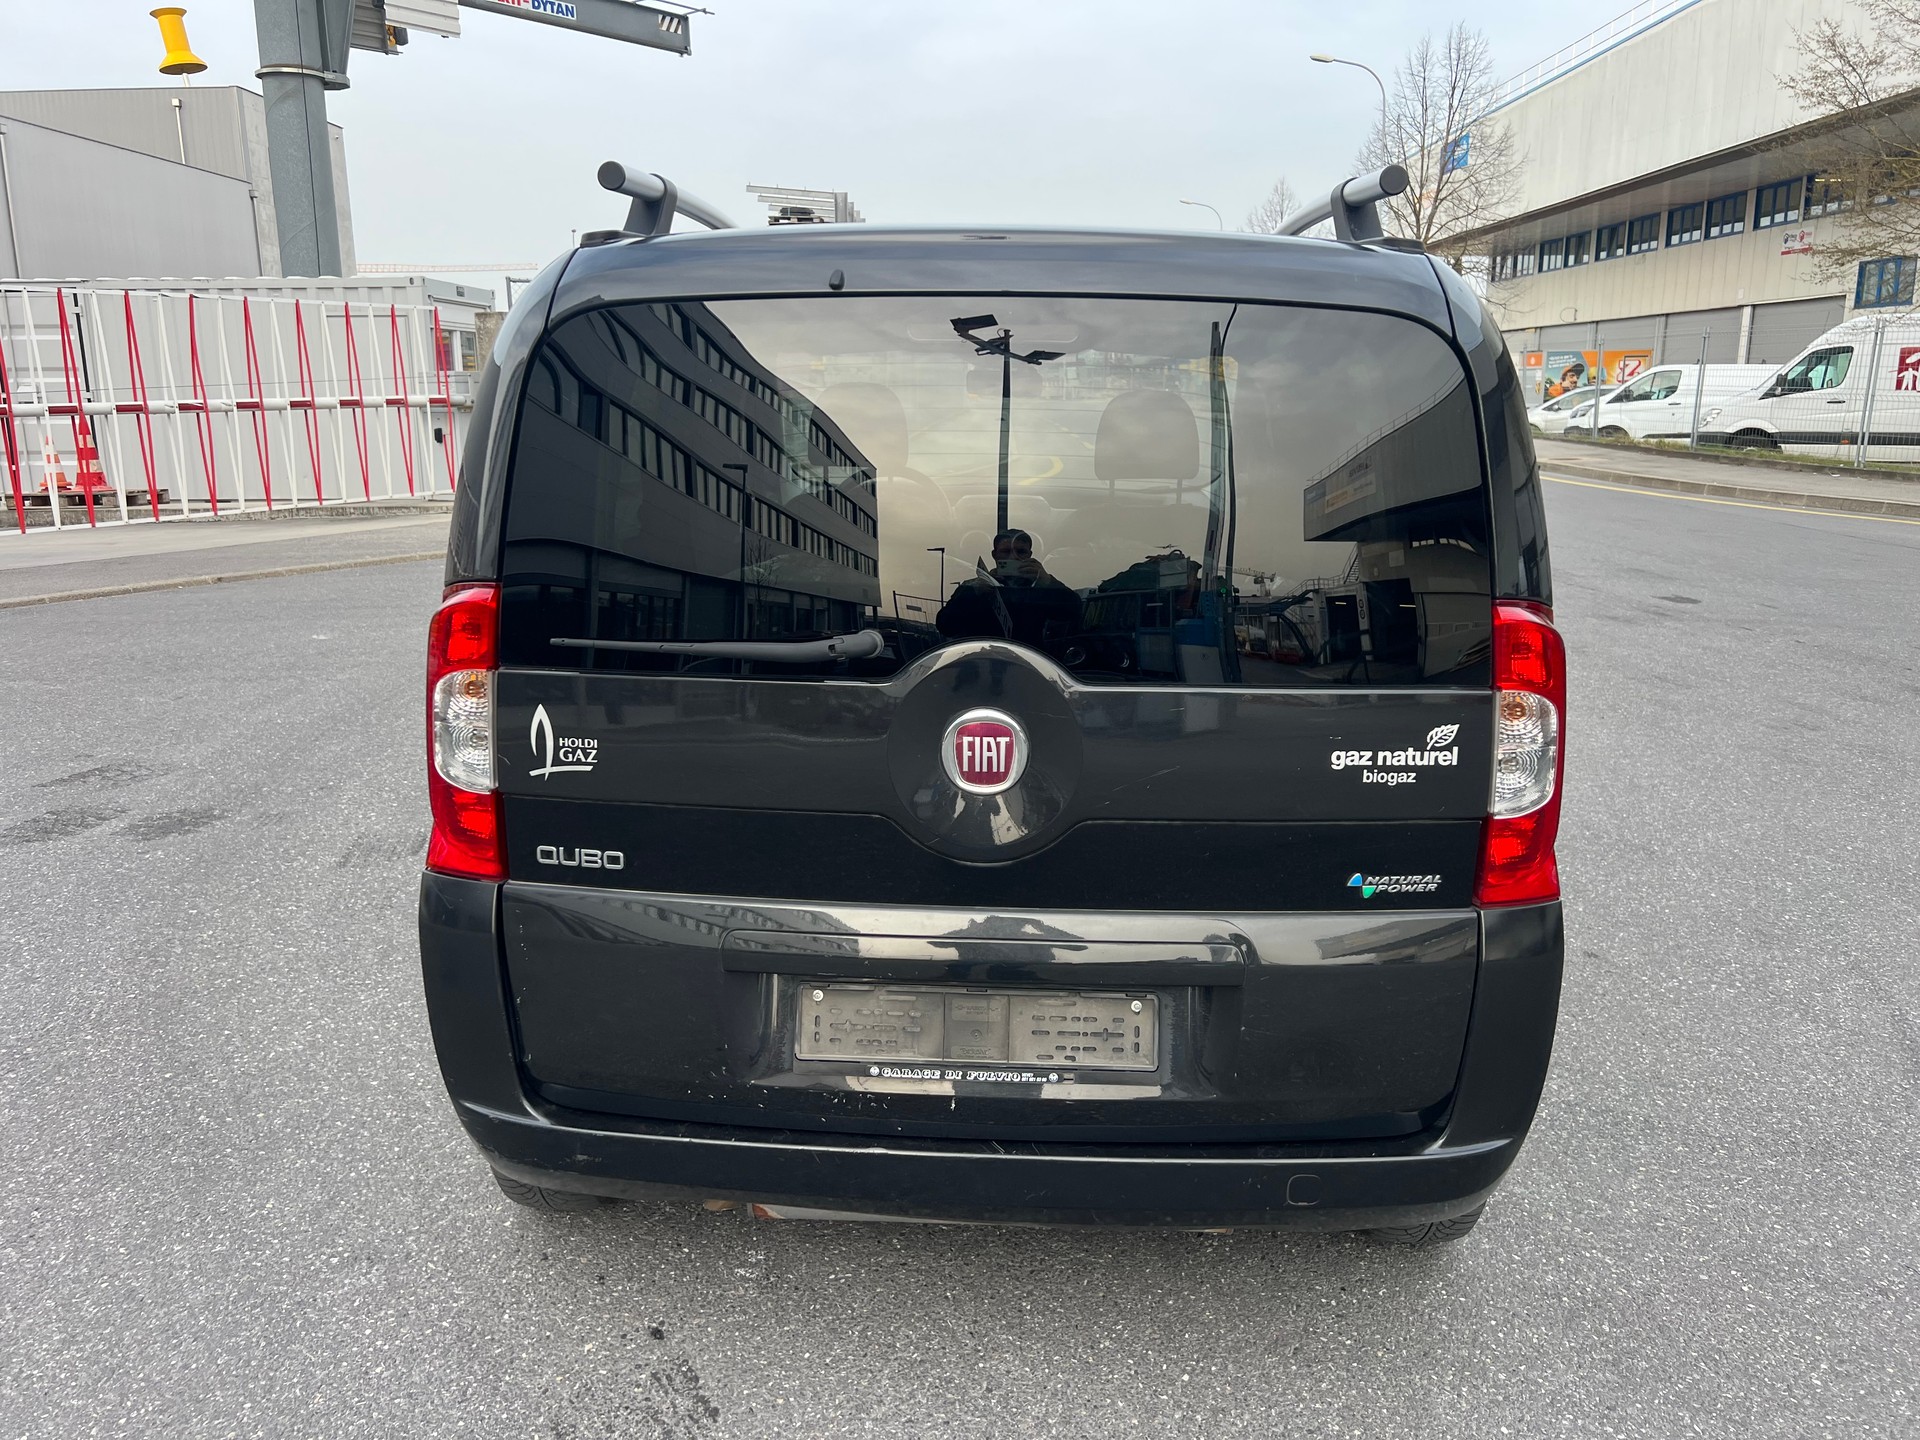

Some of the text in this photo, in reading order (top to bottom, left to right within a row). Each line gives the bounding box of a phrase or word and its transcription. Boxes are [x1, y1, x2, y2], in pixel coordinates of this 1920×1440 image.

[559, 737, 598, 749] HOLDI
[559, 748, 598, 763] GAZ
[962, 736, 1010, 772] FIAT
[1330, 746, 1459, 770] gaz naturel
[1362, 769, 1417, 785] biogaz
[536, 845, 624, 870] QUBO
[1365, 874, 1442, 885] NATURAL
[1375, 882, 1438, 893] POWER
[881, 1067, 941, 1079] GARAGE
[944, 1070, 963, 1080] DI
[966, 1071, 1020, 1081] FULVIO
